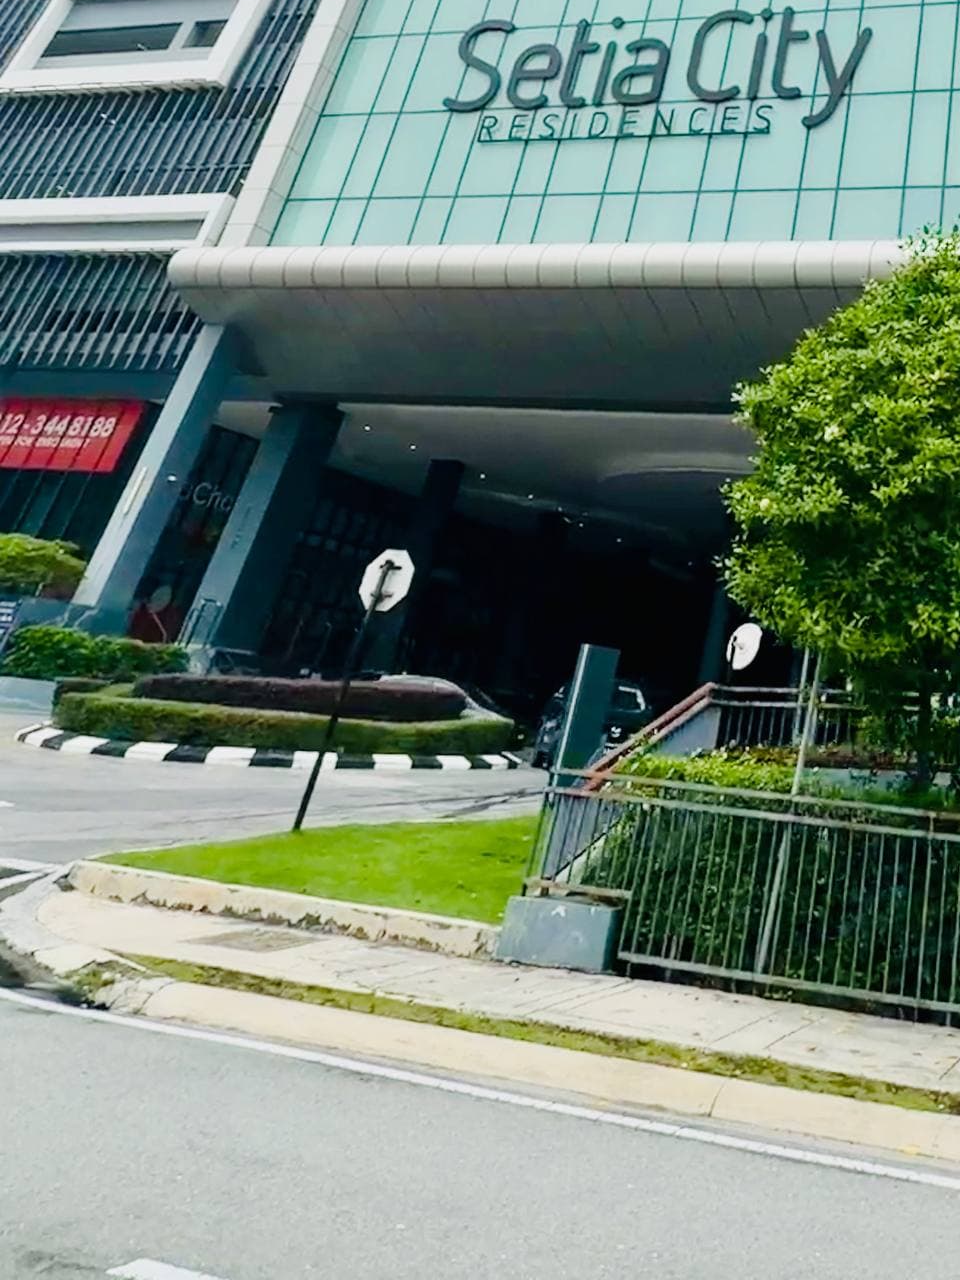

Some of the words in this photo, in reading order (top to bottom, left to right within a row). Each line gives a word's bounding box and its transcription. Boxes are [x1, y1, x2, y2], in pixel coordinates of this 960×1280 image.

[443, 16, 671, 114] Setia
[686, 6, 872, 128] City
[479, 104, 773, 139] RESIDENCES
[0, 413, 117, 438] 12-3448188
